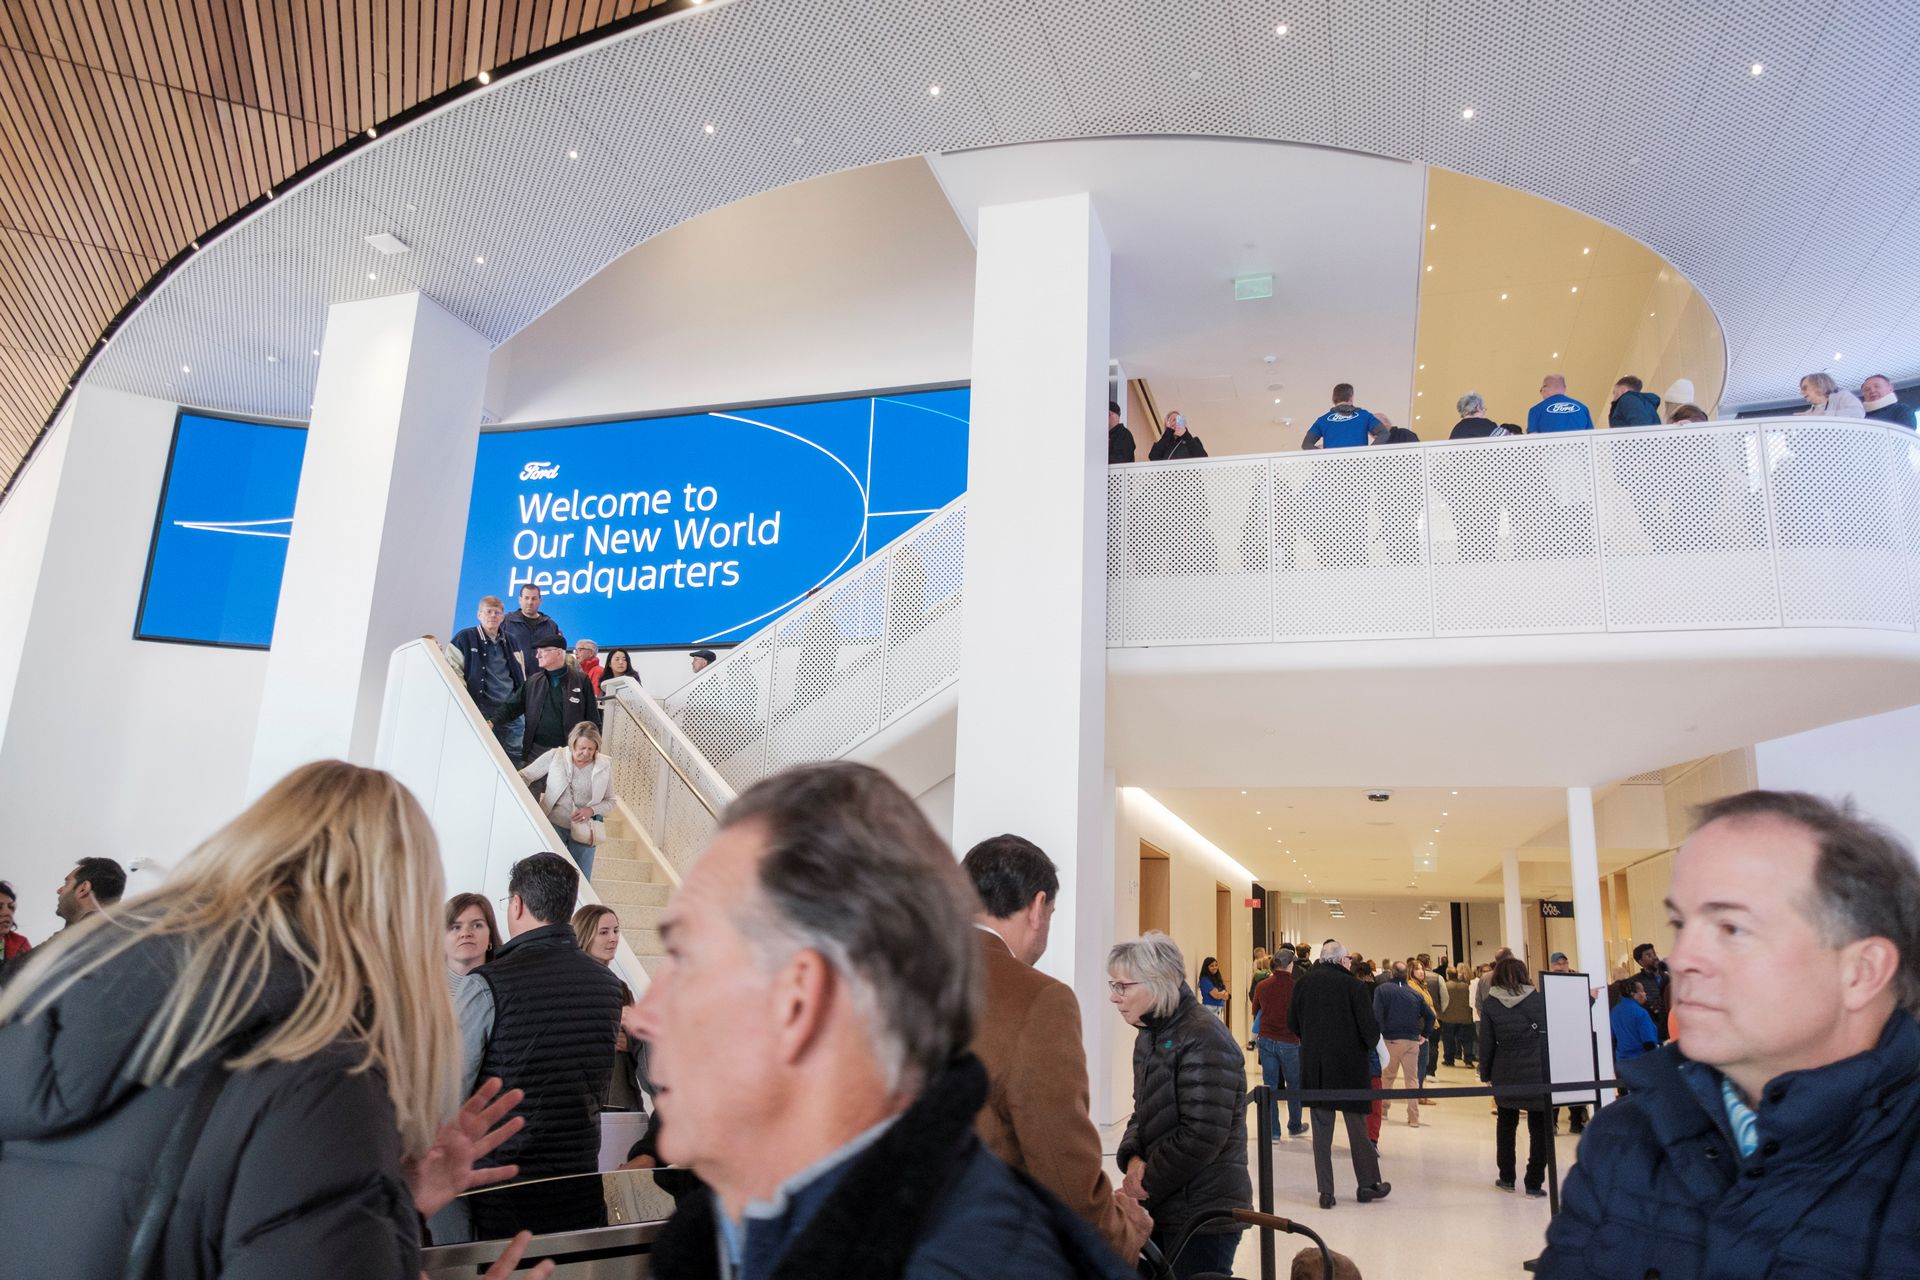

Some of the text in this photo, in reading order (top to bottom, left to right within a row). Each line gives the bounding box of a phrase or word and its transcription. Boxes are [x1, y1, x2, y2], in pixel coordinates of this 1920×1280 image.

[1551, 403, 1577, 412] Ford
[519, 462, 560, 480] Ford
[519, 483, 718, 524] Welcome to
[512, 511, 781, 560] Our New World
[508, 559, 740, 598] Headquarters
